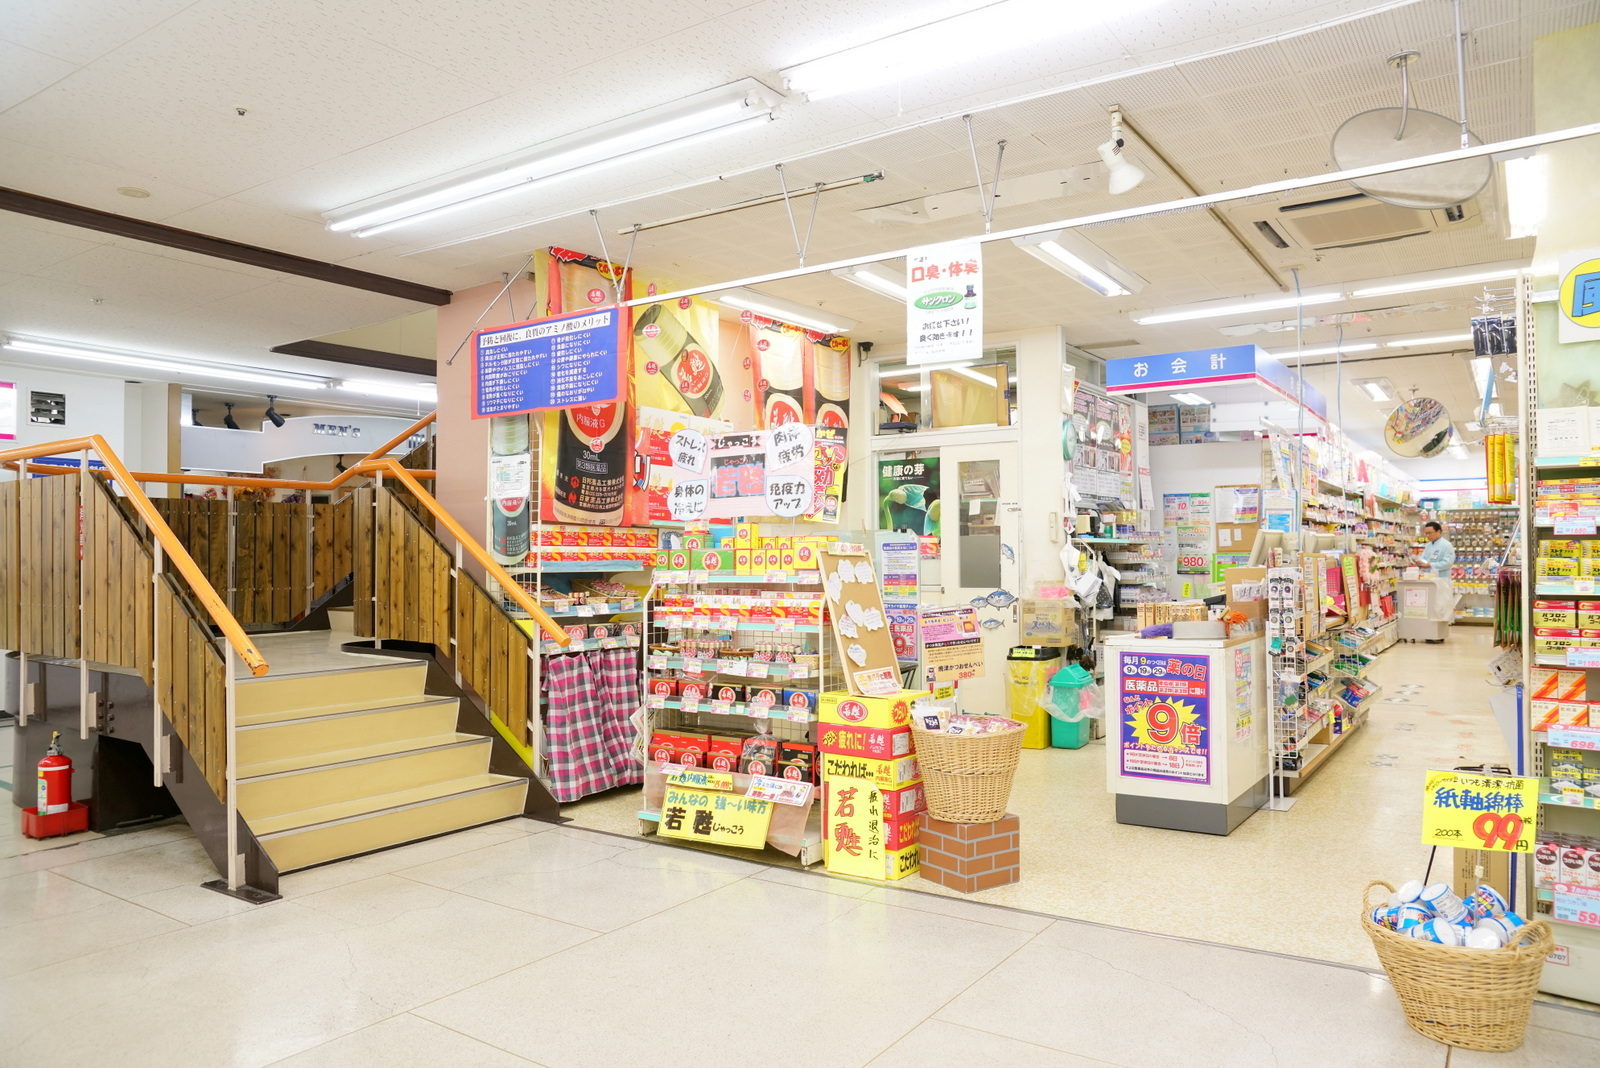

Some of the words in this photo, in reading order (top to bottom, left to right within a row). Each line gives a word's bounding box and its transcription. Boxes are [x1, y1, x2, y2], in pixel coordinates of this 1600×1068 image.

[1133, 353, 1227, 378] お会計
[576, 412, 606, 429] 内服液G
[313, 423, 361, 438] MEN'S
[815, 428, 836, 440] かぜ
[717, 436, 758, 448] じゃっこう
[582, 450, 600, 462] 30mL
[677, 452, 696, 467] 疲れ
[882, 463, 925, 478] 健康の芽
[674, 484, 705, 498] 身体の
[769, 481, 806, 496] 免疫力
[773, 498, 801, 510] アップ
[1183, 556, 1204, 567] 980
[1166, 658, 1207, 682] 薬の日
[1125, 679, 1158, 692] 医薬品
[1146, 702, 1179, 745] 9
[838, 729, 867, 751] 疲れに!
[1180, 722, 1201, 745] 倍
[1570, 740, 1595, 749] 698
[667, 791, 709, 807] みんなの
[1433, 786, 1524, 813] 紙軸綿棒
[664, 806, 714, 836] 若甦
[712, 822, 744, 836] じゃっこう
[1435, 828, 1463, 839] 200本
[1472, 812, 1524, 850] 99
[1515, 839, 1529, 851] 円
[1578, 910, 1600, 925] 59
